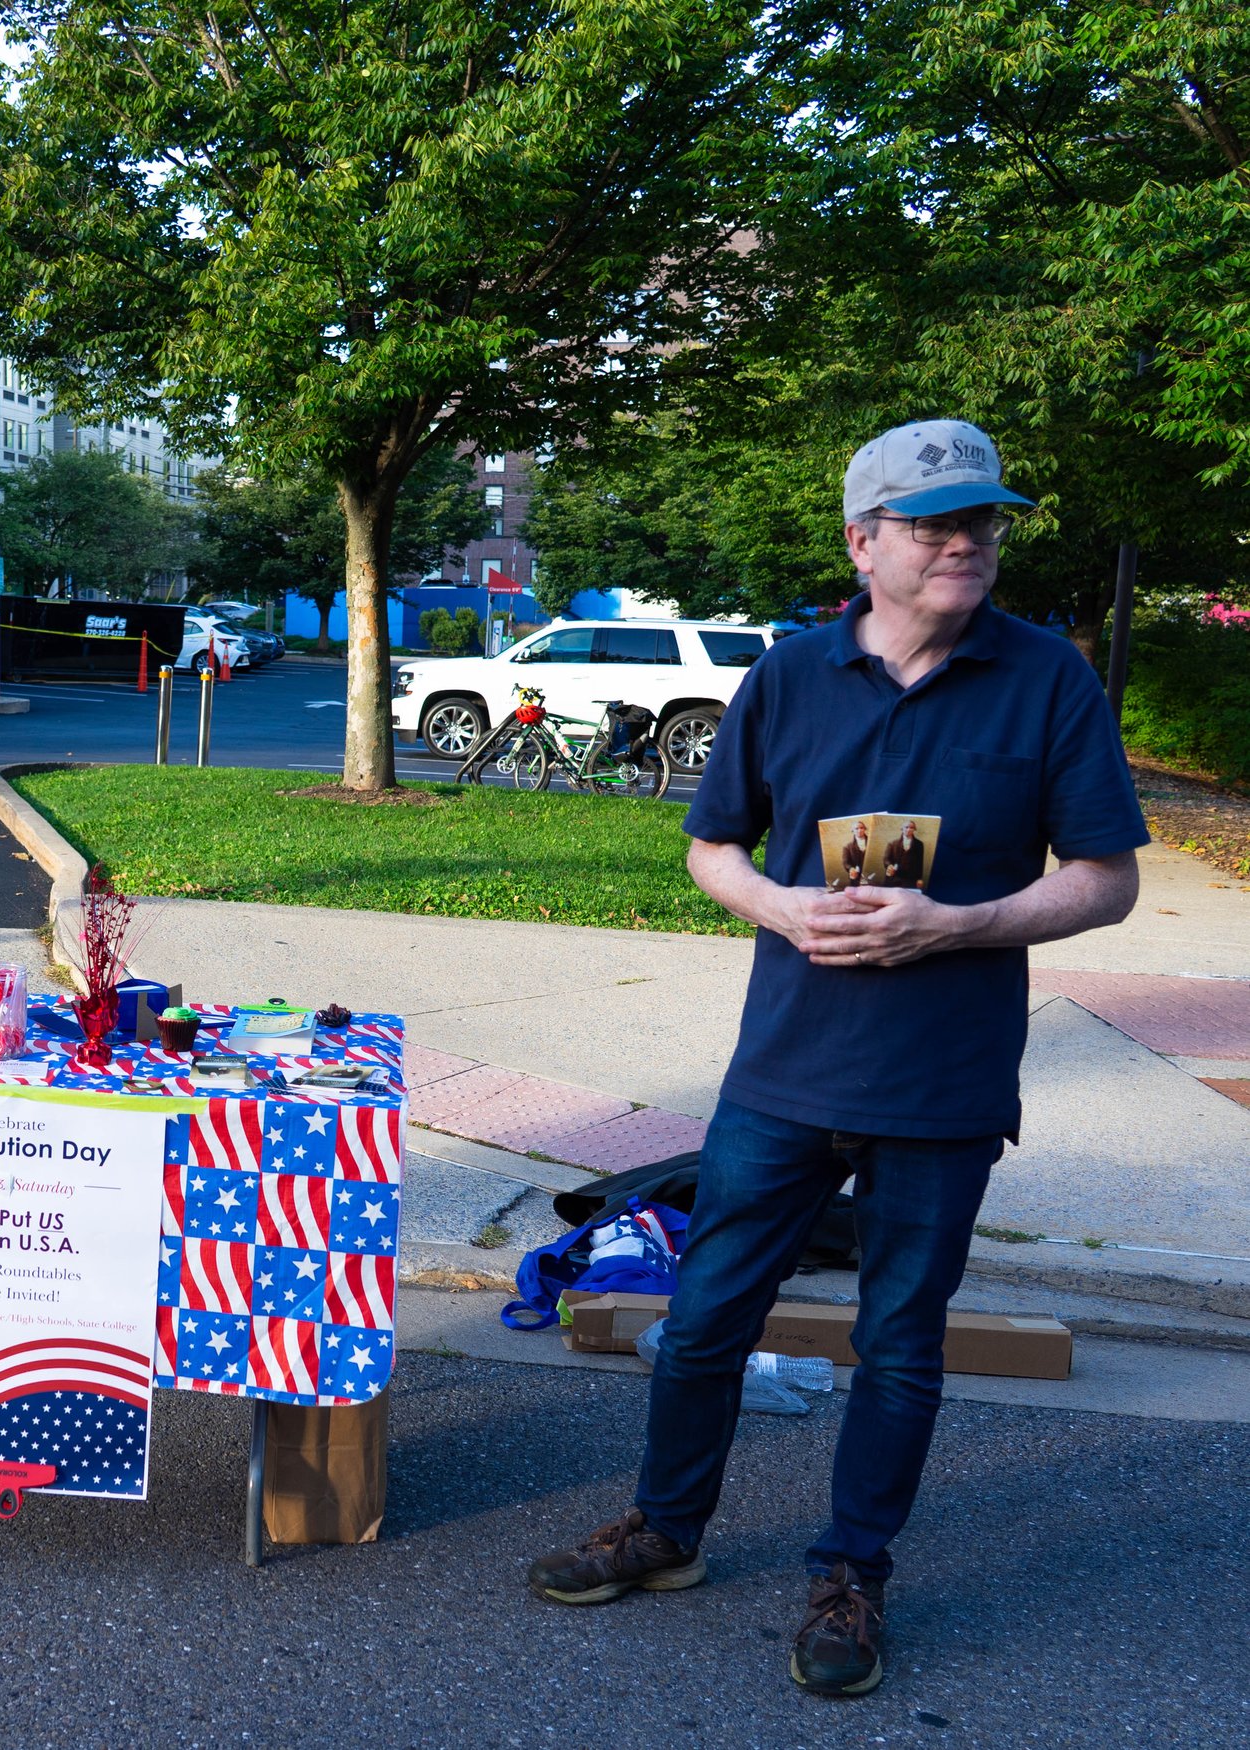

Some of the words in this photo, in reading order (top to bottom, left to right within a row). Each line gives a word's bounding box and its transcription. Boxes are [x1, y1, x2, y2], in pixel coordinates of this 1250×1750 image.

[952, 439, 987, 463] Sun
[85, 614, 127, 630] Saar's
[62, 1140, 112, 1167] Day
[14, 1178, 75, 1199] Saturday
[0, 1209, 32, 1228] Put
[38, 1212, 65, 1231] US
[19, 1234, 80, 1255] U.S.A.
[7, 1287, 61, 1303] Invited!
[37, 1315, 76, 1328] Schools,
[77, 1319, 100, 1329] State
[102, 1320, 138, 1333] College
